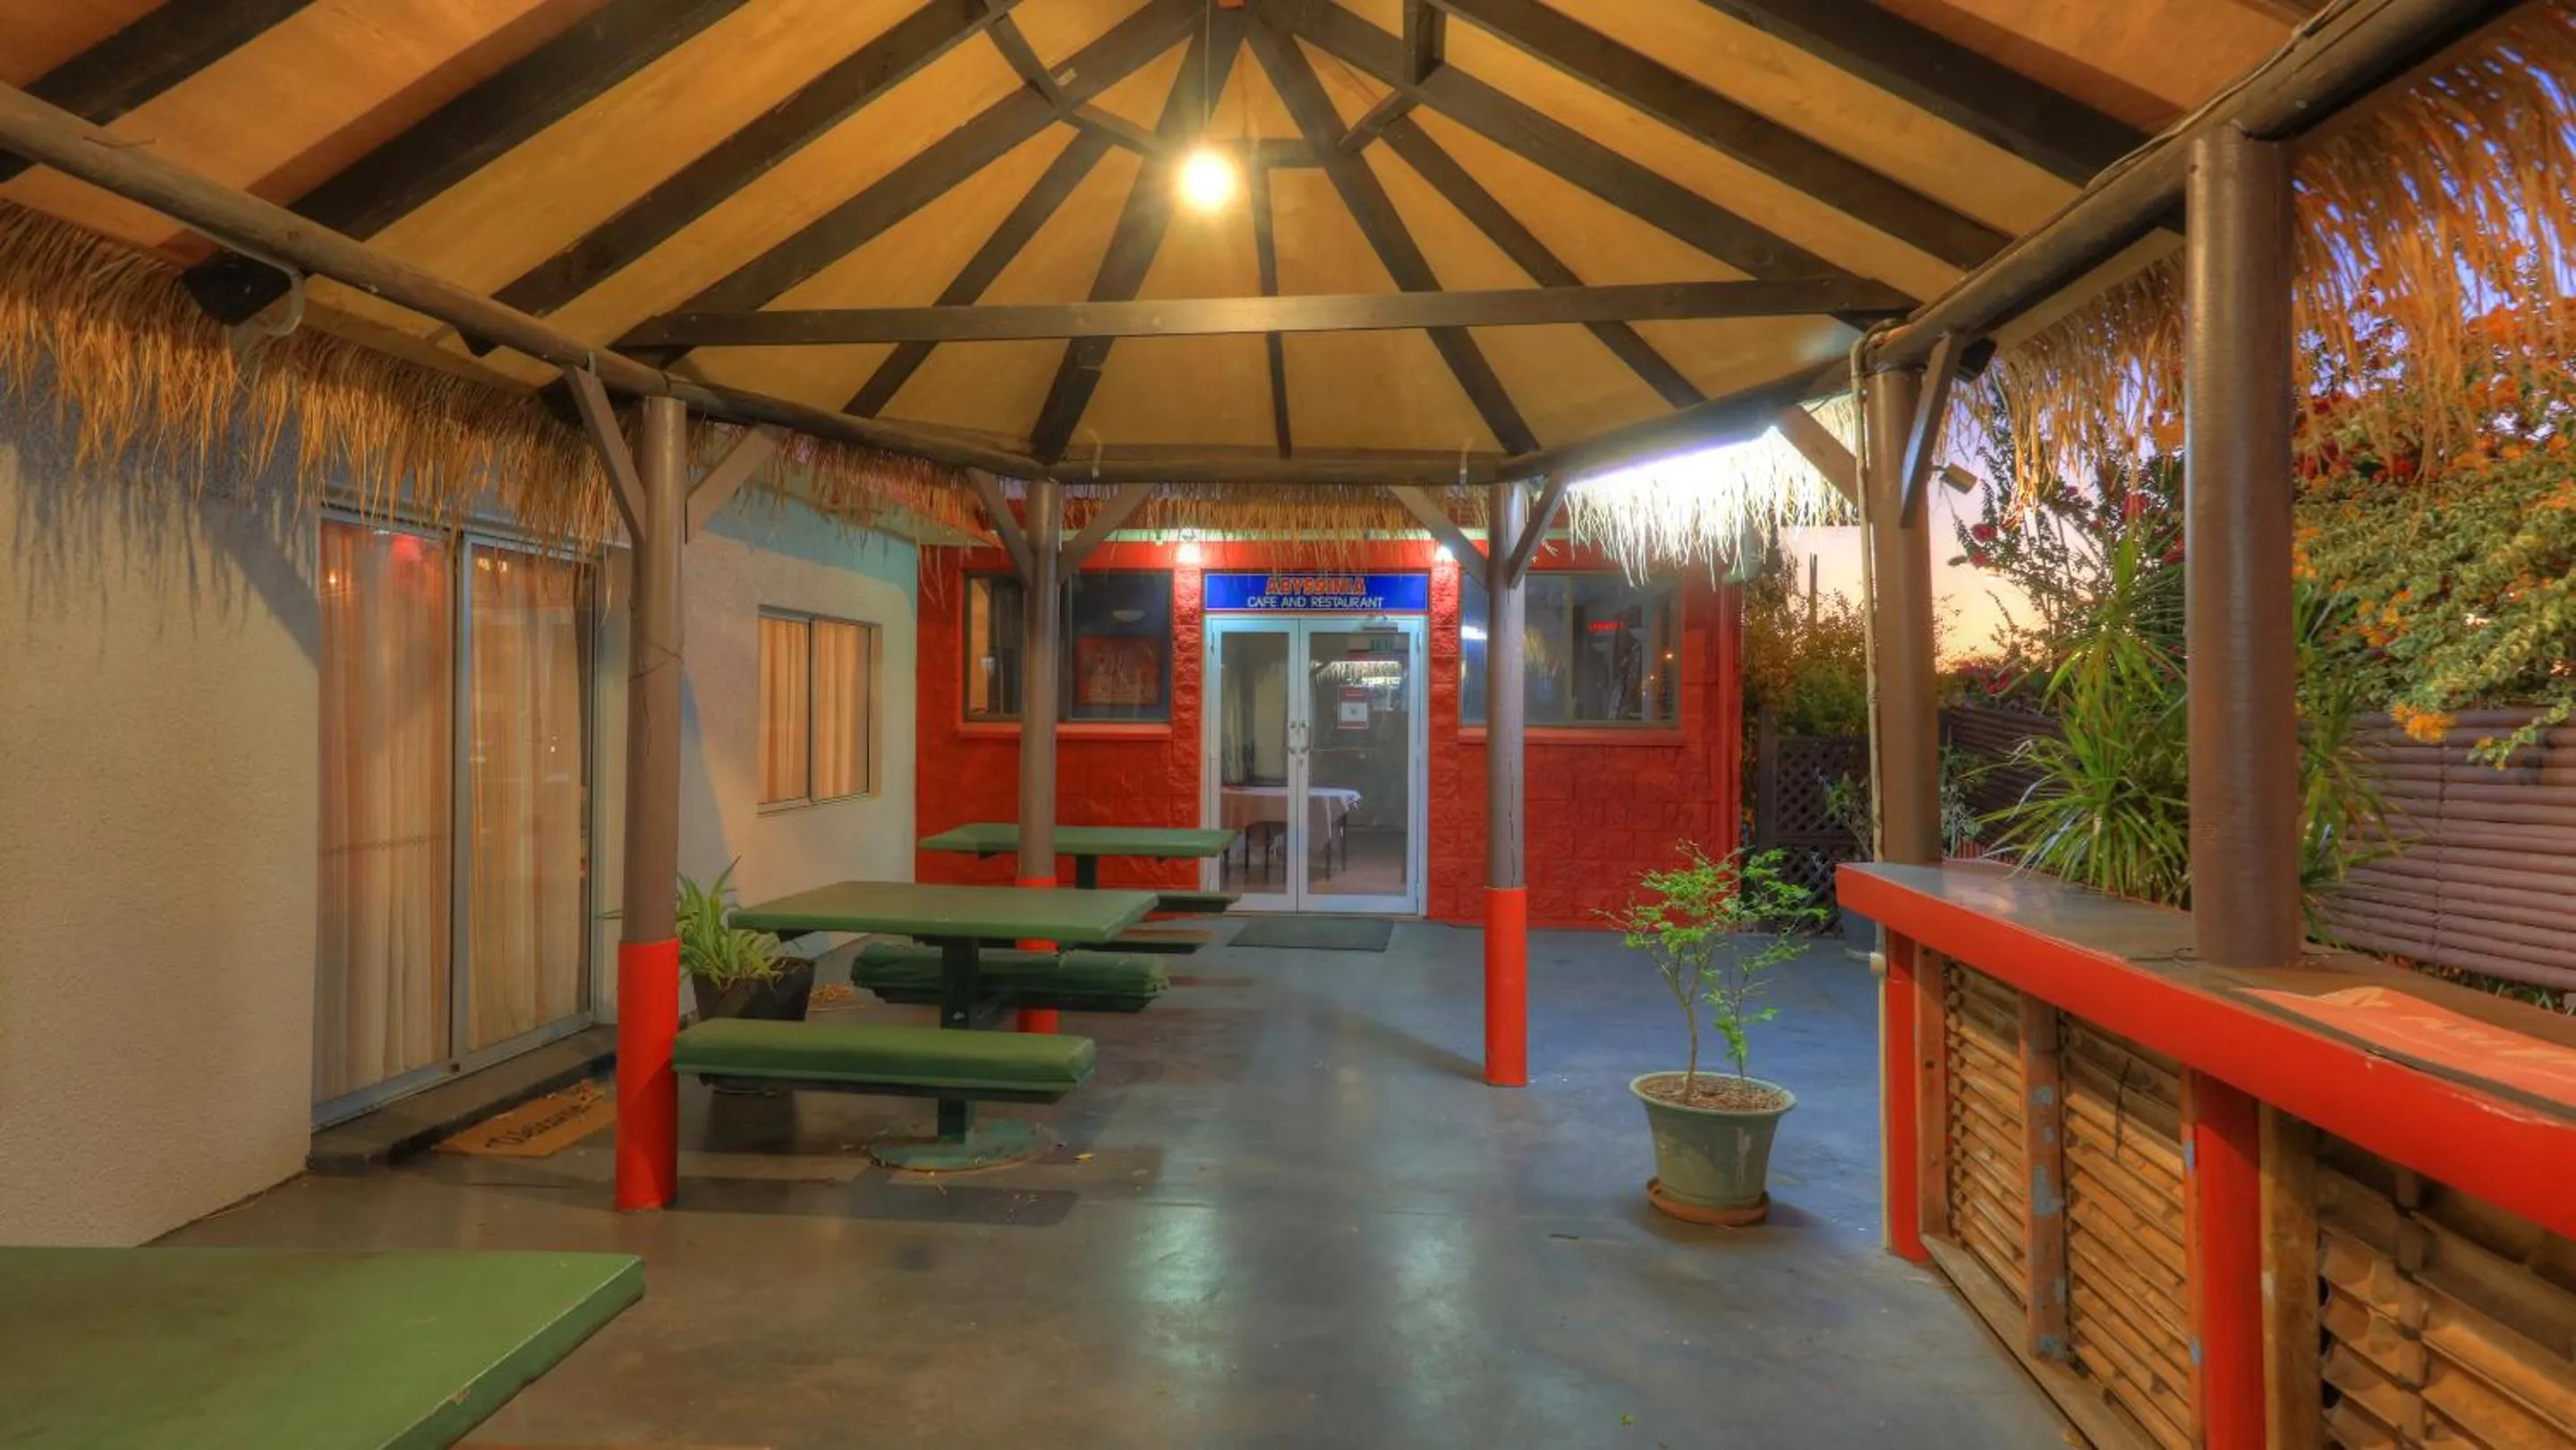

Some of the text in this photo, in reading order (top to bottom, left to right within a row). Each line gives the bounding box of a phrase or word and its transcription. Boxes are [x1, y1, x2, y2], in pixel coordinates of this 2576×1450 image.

[1247, 596, 1383, 608] CAFE AND RESTAURANT
